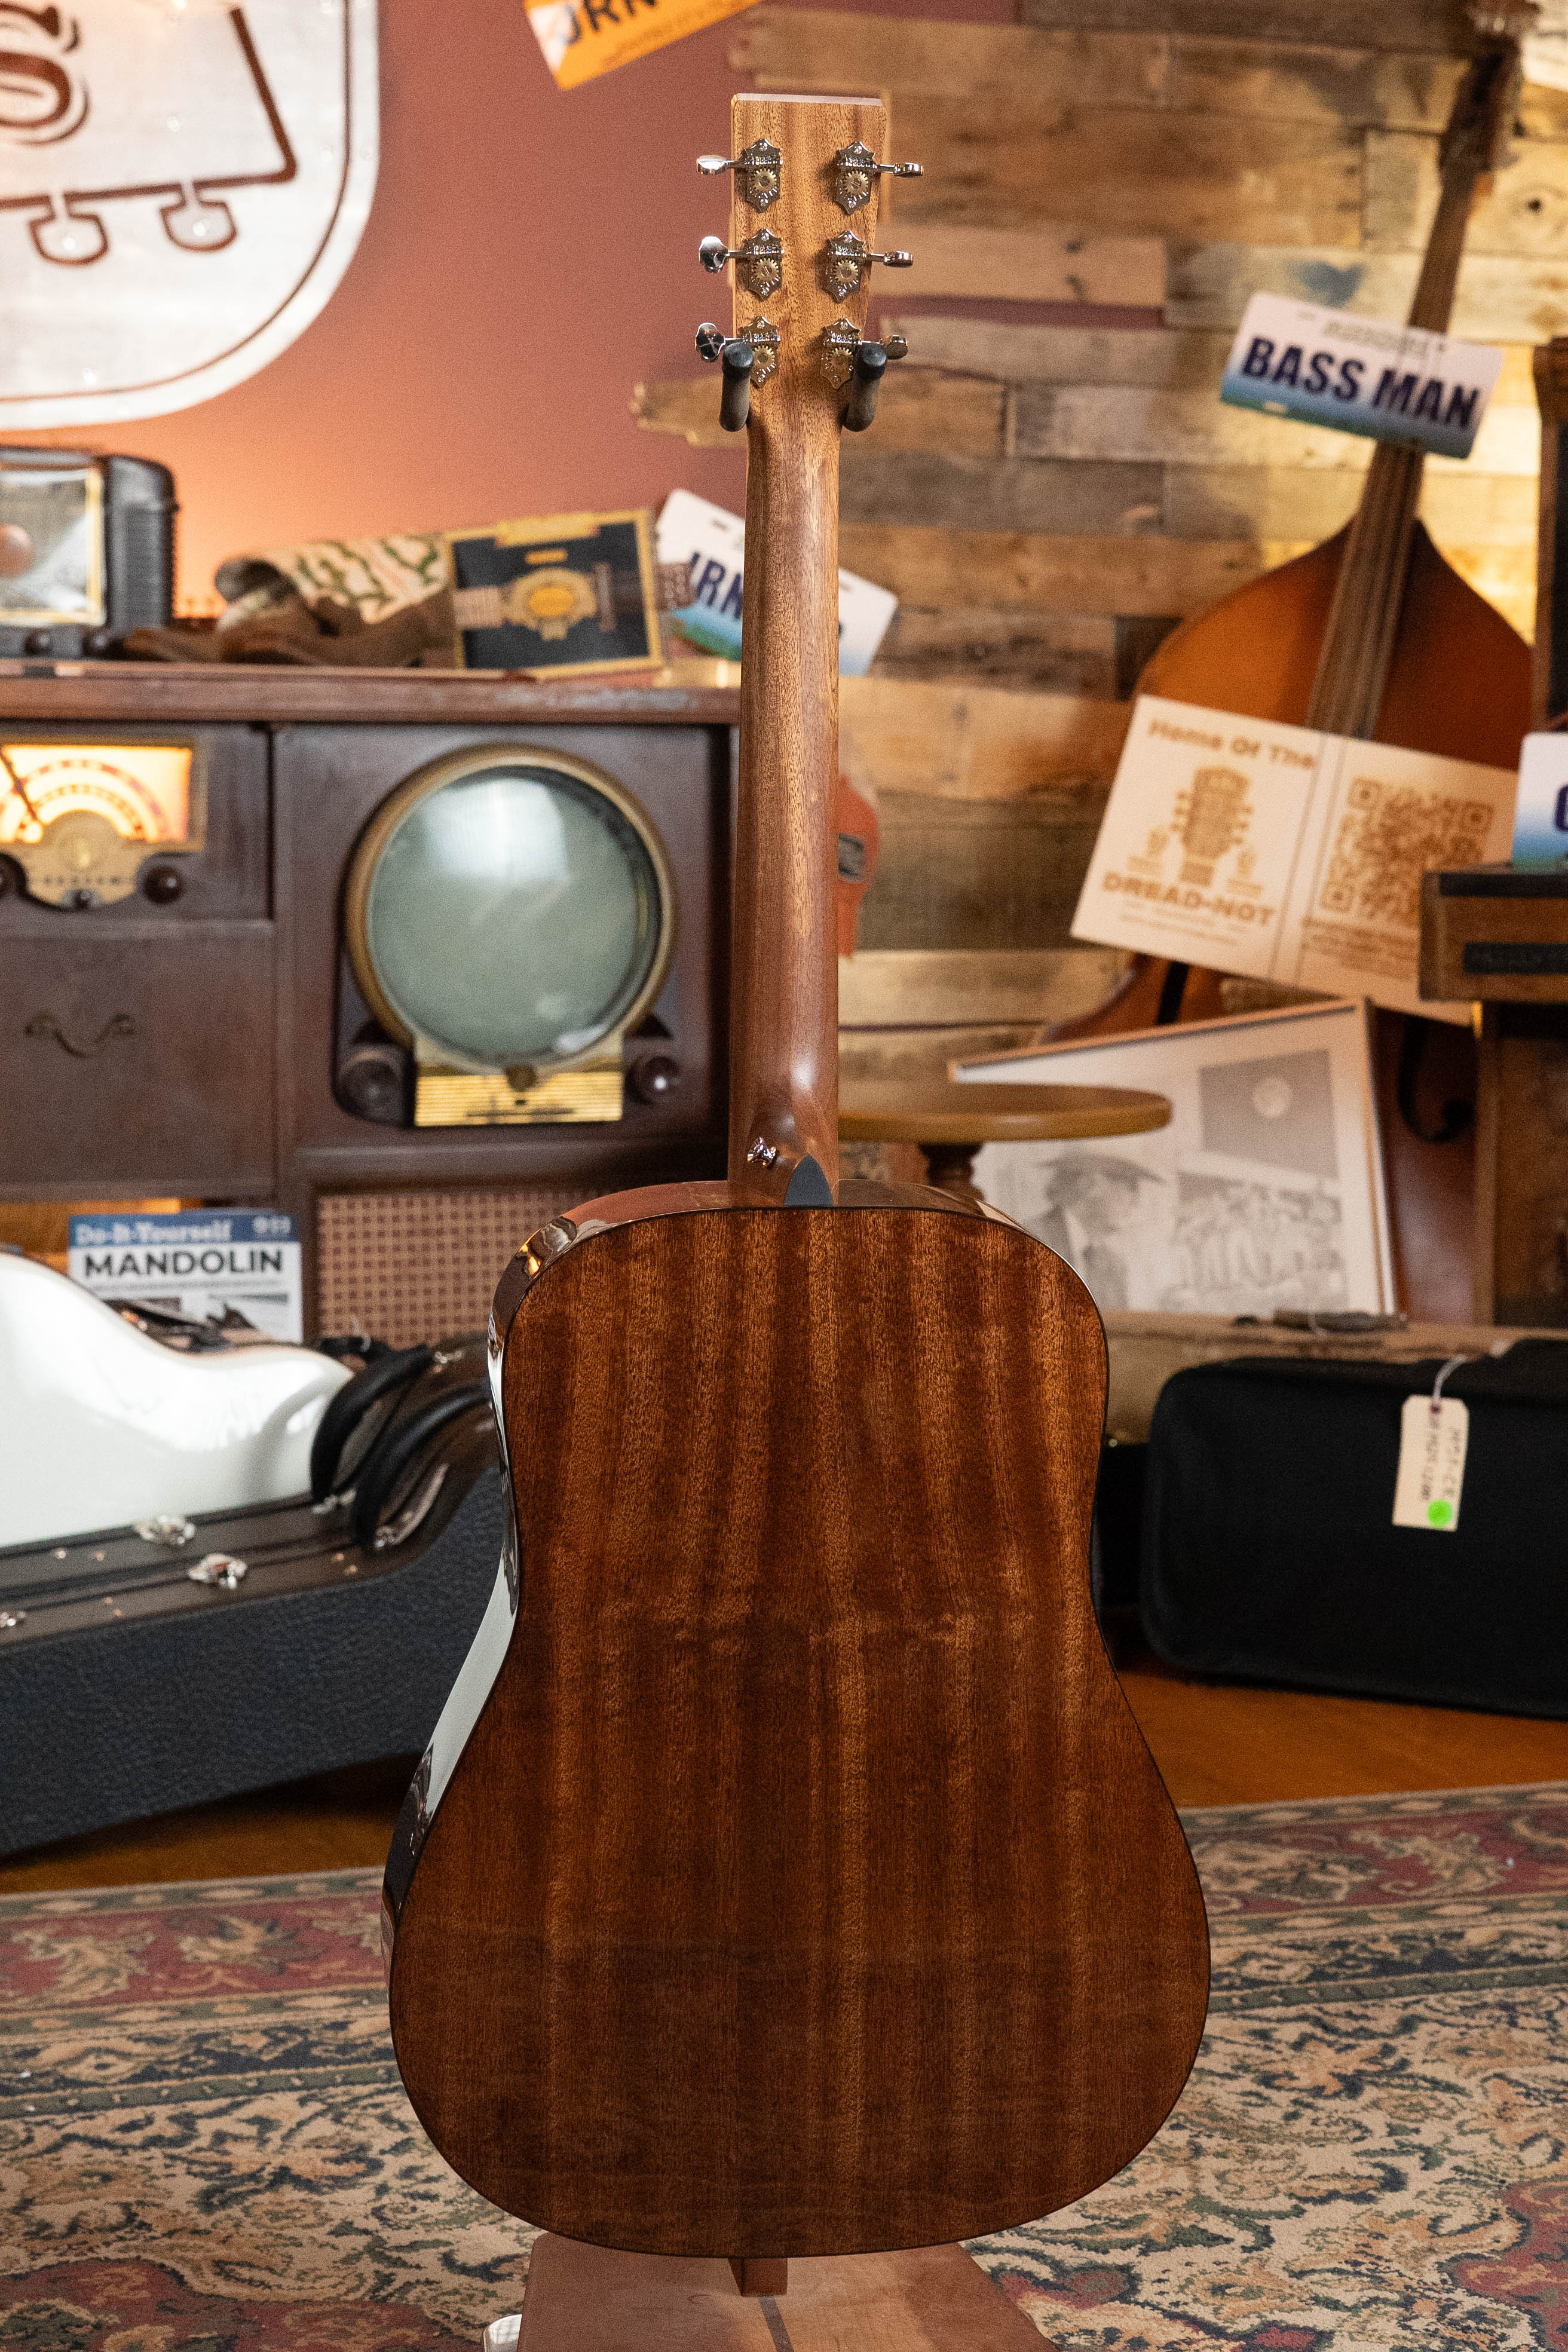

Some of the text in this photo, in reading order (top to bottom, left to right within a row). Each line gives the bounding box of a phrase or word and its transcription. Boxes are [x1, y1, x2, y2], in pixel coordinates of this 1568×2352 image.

[1241, 336, 1365, 402] BASS
[1371, 368, 1481, 430] MAN
[1148, 719, 1224, 751] Home
[1103, 871, 1276, 926] DREAD-NOT
[85, 1249, 284, 1278] MANDOLIN
